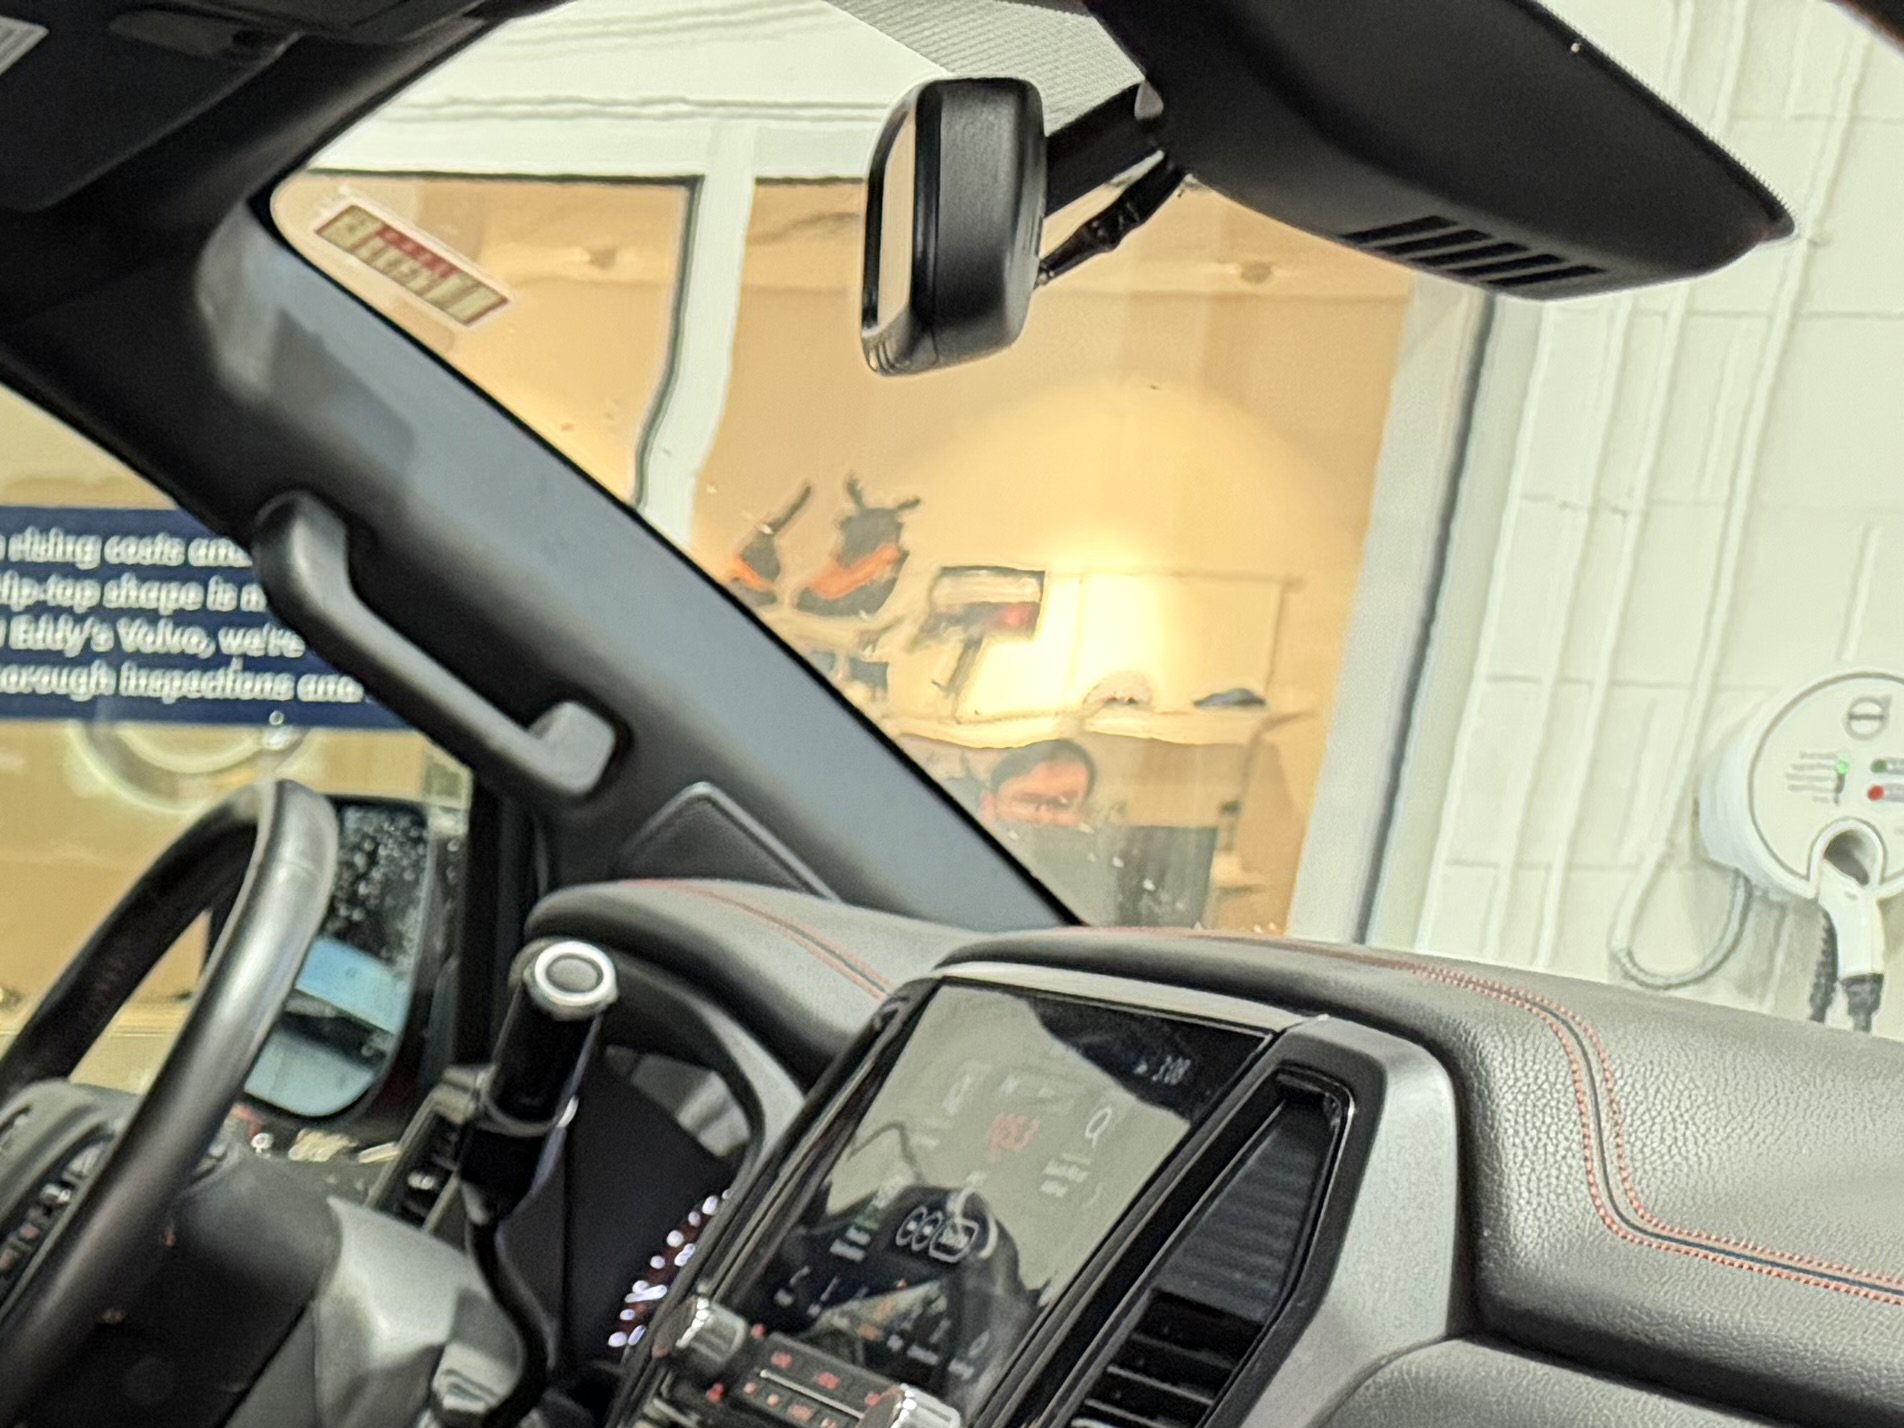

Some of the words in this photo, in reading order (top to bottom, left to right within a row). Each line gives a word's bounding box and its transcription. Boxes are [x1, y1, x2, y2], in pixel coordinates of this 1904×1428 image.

[8, 526, 102, 570] rising
[104, 532, 185, 567] costs
[103, 572, 204, 616] shape
[206, 575, 238, 612] is
[9, 613, 114, 658] Eddy's
[116, 617, 216, 659] Volvo,
[218, 622, 306, 658] we're
[119, 655, 296, 704] inspections
